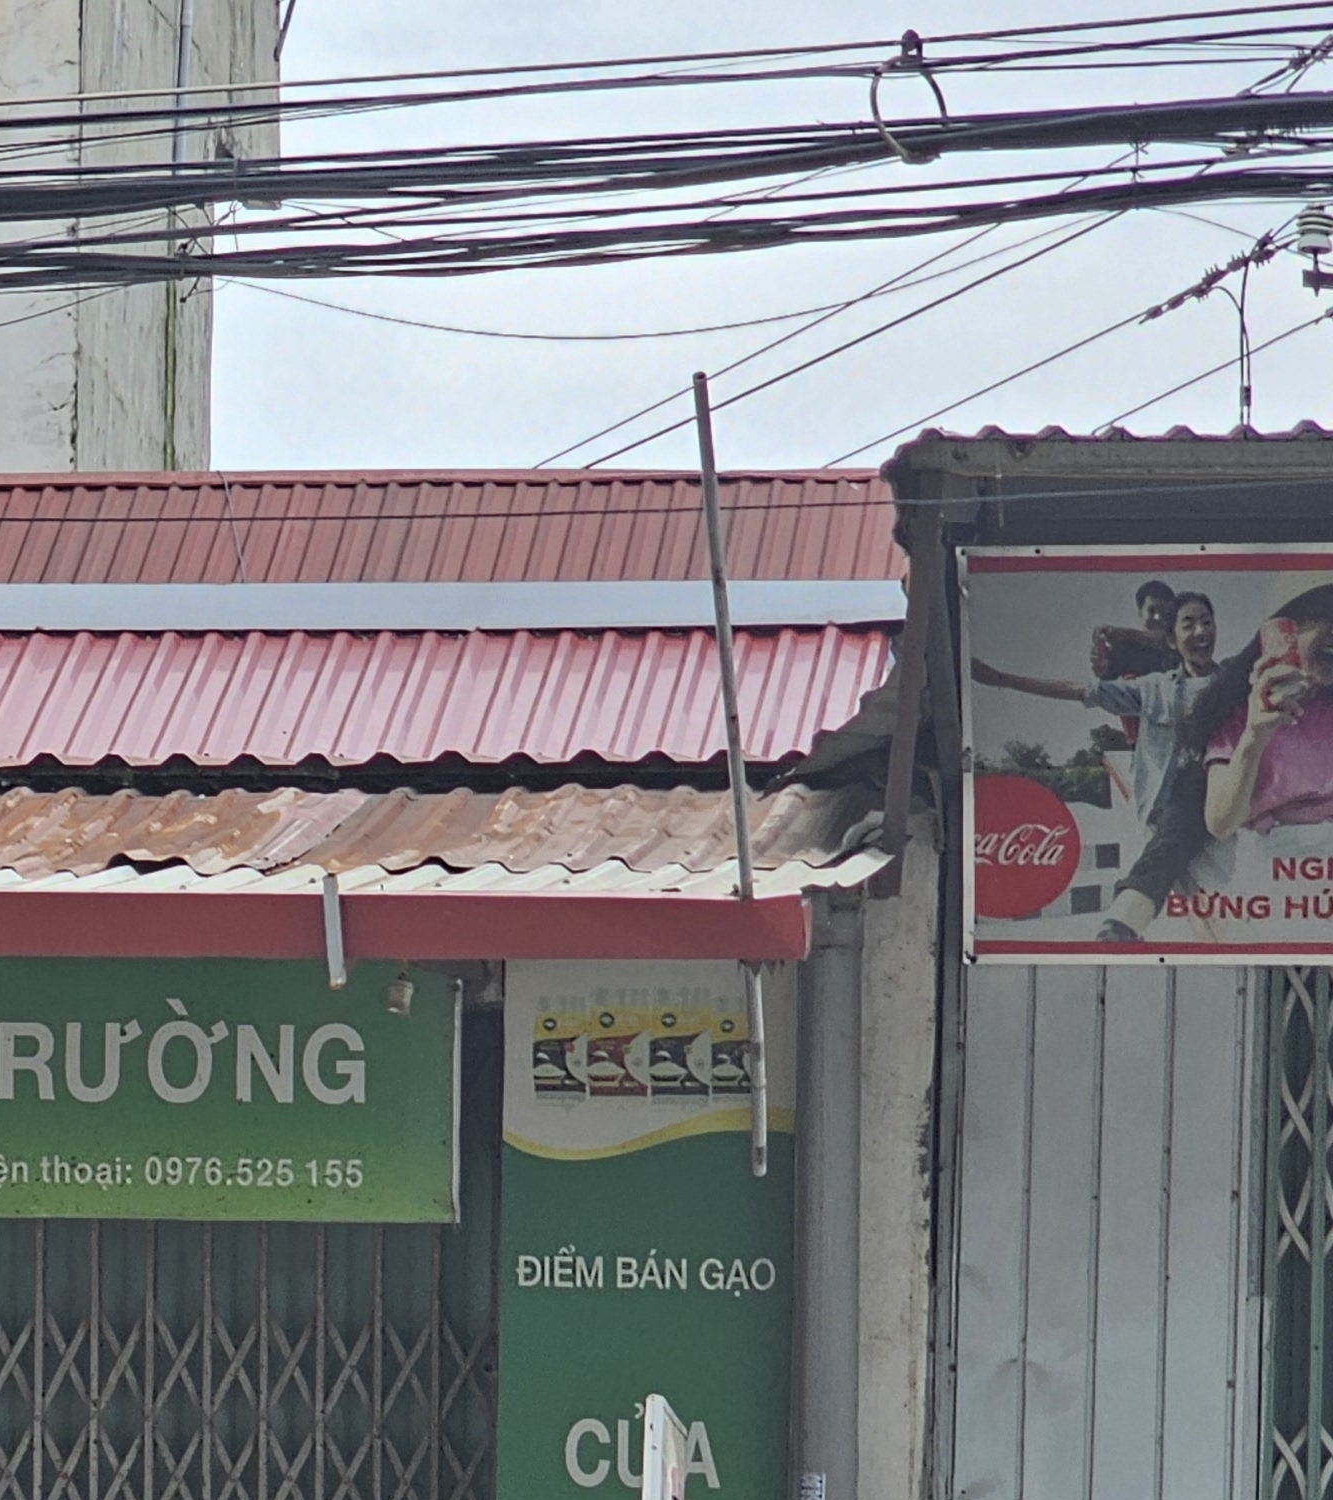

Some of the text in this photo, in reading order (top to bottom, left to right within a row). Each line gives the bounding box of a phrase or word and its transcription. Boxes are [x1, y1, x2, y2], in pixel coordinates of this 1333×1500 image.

[1166, 887, 1271, 919] BỪNG
[39, 1156, 133, 1189] thoại:
[144, 1157, 294, 1186] 0976.525
[305, 1159, 363, 1187] 155
[516, 1244, 775, 1297] ĐIỂM BÁN GẠO
